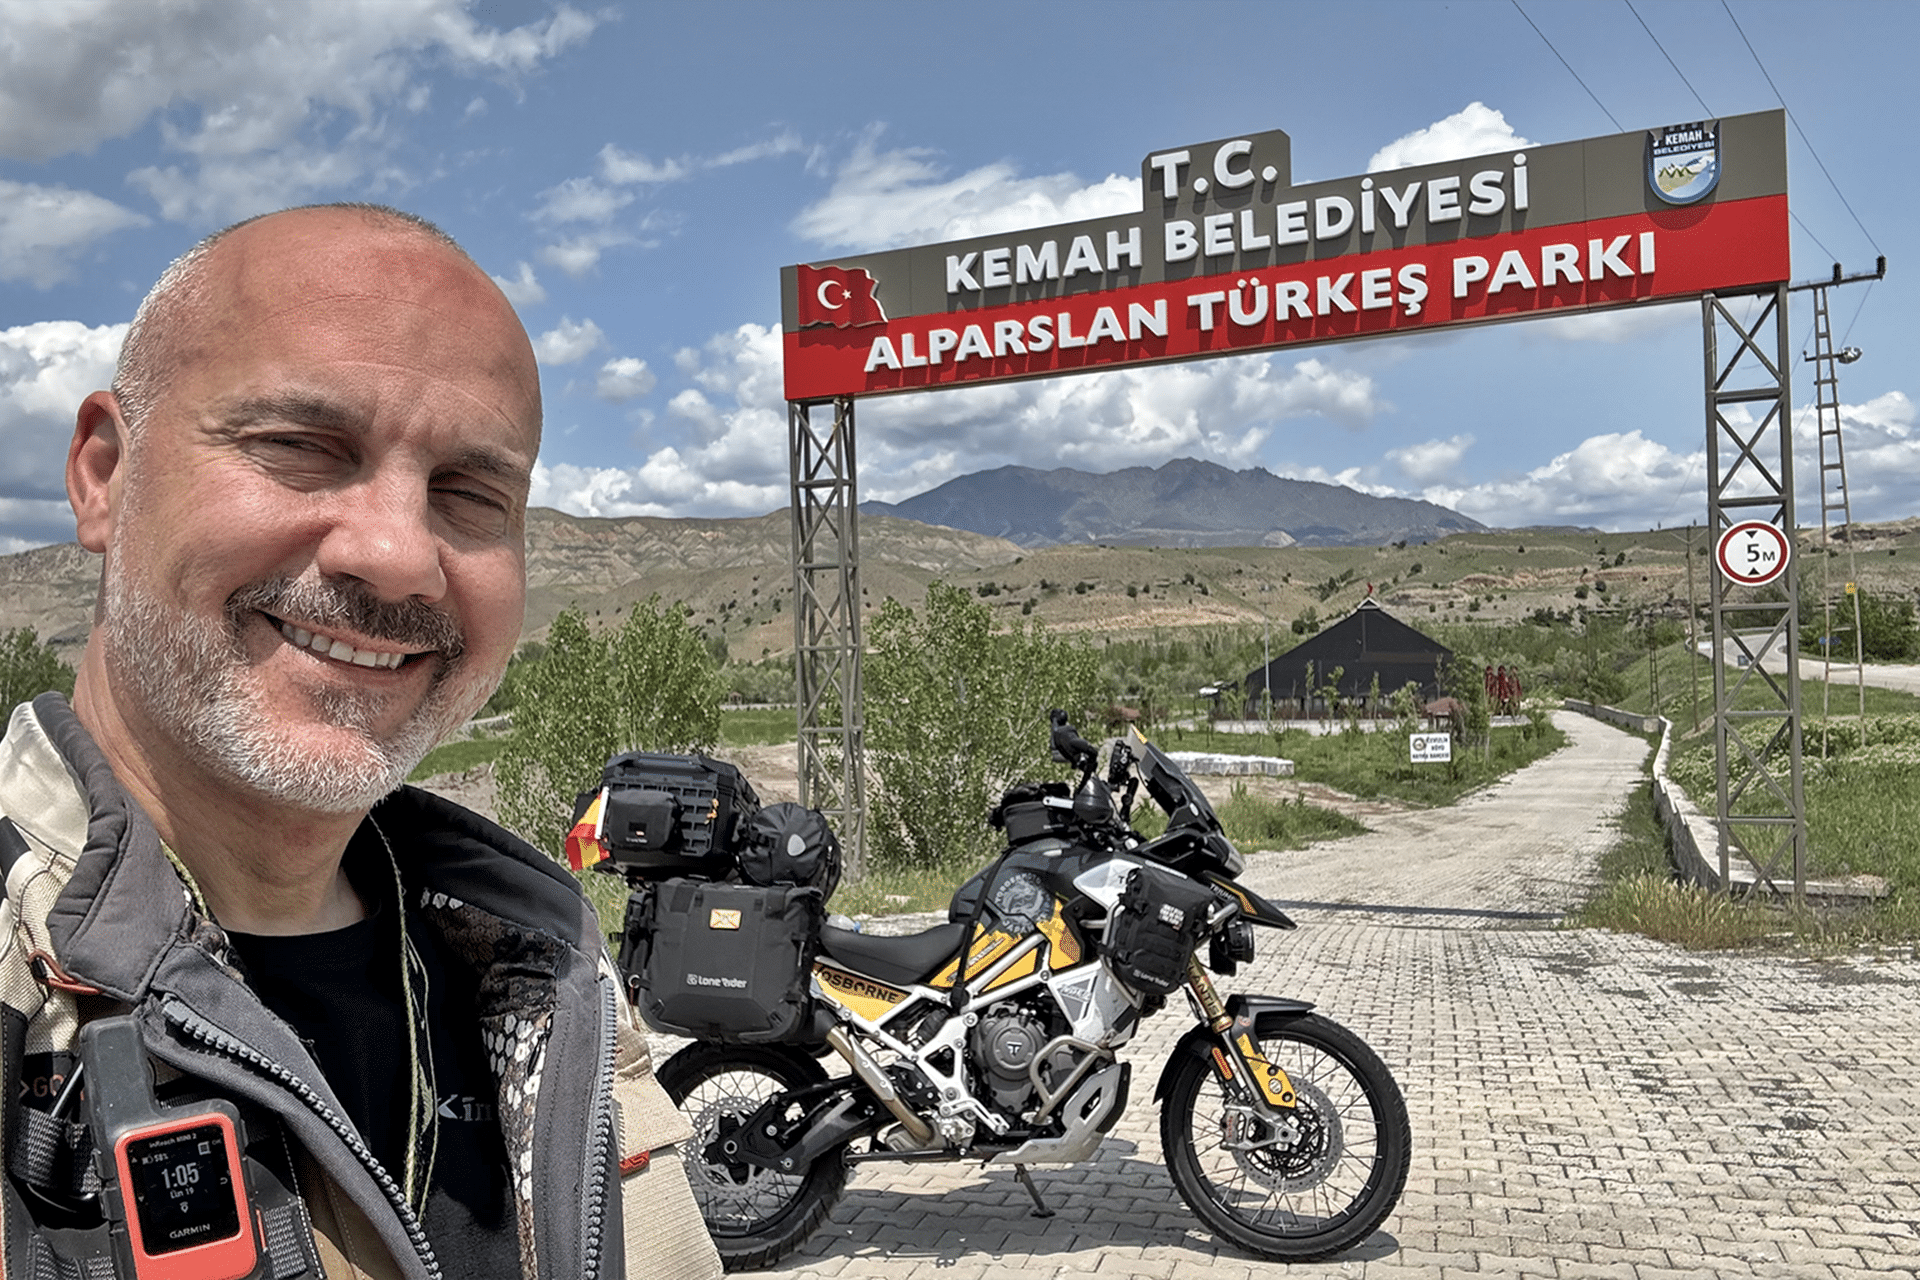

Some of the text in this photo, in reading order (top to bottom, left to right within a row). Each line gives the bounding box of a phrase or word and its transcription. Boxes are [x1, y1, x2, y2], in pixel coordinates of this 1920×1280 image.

[1665, 130, 1703, 146] KEMAH
[1151, 139, 1279, 199] T.C.
[946, 153, 1529, 294] KEMAH BELEDİYESİ
[864, 231, 1656, 372] ALPARSLAN TÜRKEŞ PARKI
[821, 970, 899, 1005] OSBORNE
[161, 1162, 200, 1189] 1:05
[169, 1223, 211, 1239] GARMIN
